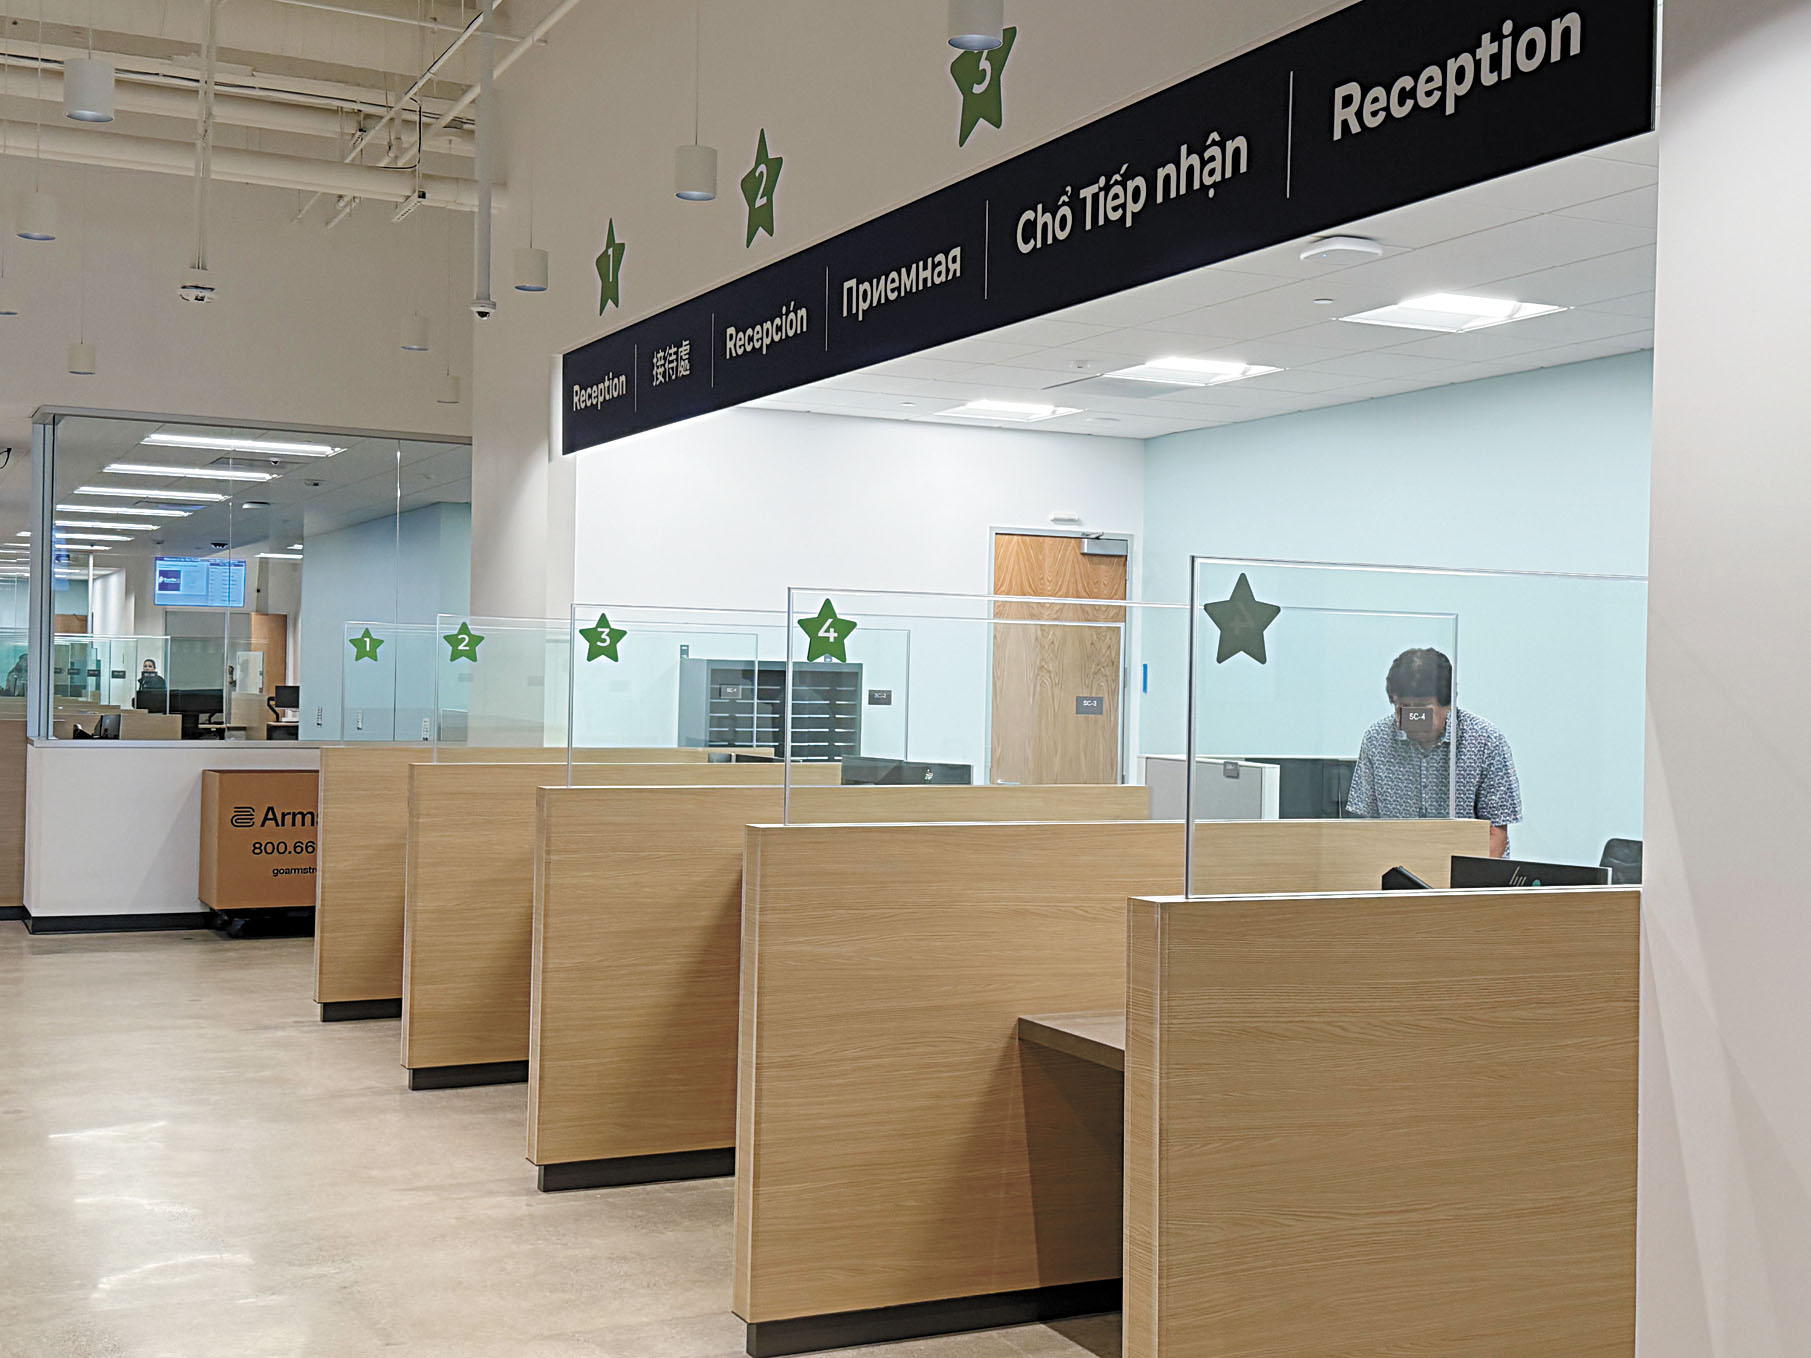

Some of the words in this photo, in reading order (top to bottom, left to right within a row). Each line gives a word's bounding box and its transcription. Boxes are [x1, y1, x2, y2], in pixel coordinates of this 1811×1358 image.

[1333, 11, 1582, 142] Reception
[754, 163, 768, 209] 2
[1016, 185, 1073, 254] Chổ
[1079, 163, 1147, 228] Tiếp
[1156, 131, 1248, 204] nhận
[607, 247, 614, 283] 1
[842, 245, 961, 322] Приемная
[726, 300, 807, 360] Recepción
[652, 339, 691, 387] 接待處
[572, 371, 627, 412] Reception
[363, 637, 371, 651] 1
[457, 634, 470, 650] 2
[596, 627, 611, 647] 3
[817, 618, 838, 643] 4
[1409, 712, 1426, 721] SC-4
[260, 806, 319, 828] Arm
[251, 840, 317, 856] 800.66
